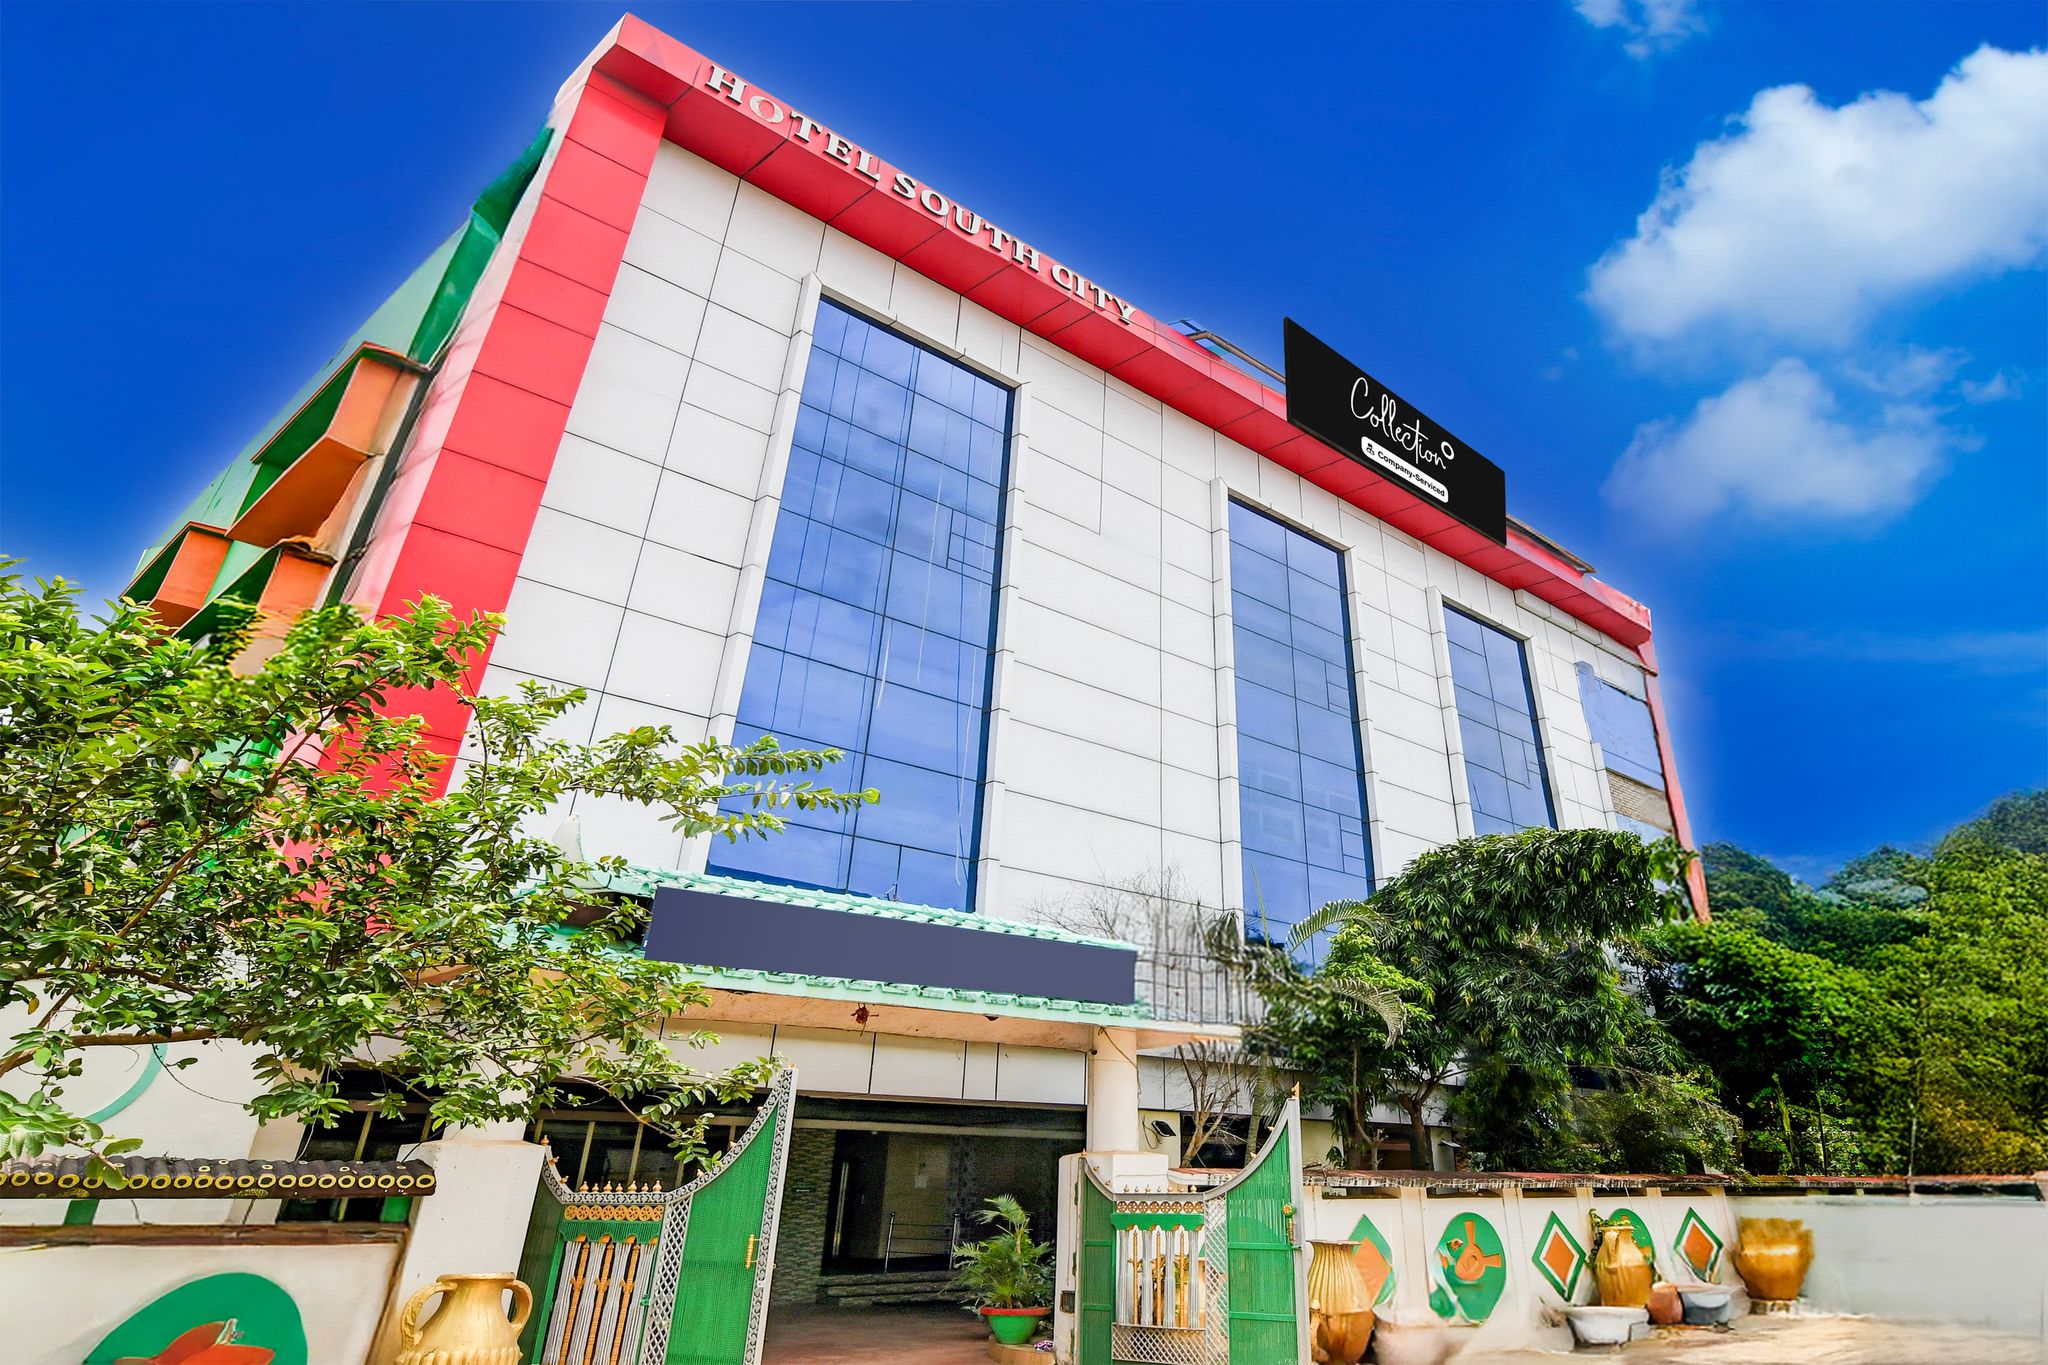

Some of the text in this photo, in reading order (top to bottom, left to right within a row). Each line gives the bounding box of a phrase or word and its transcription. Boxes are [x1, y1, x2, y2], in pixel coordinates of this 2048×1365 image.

[705, 64, 1137, 325] HOTEL SOUTH CITY
[1351, 377, 1446, 469] Collection
[1377, 451, 1445, 497] Company-Serviced
